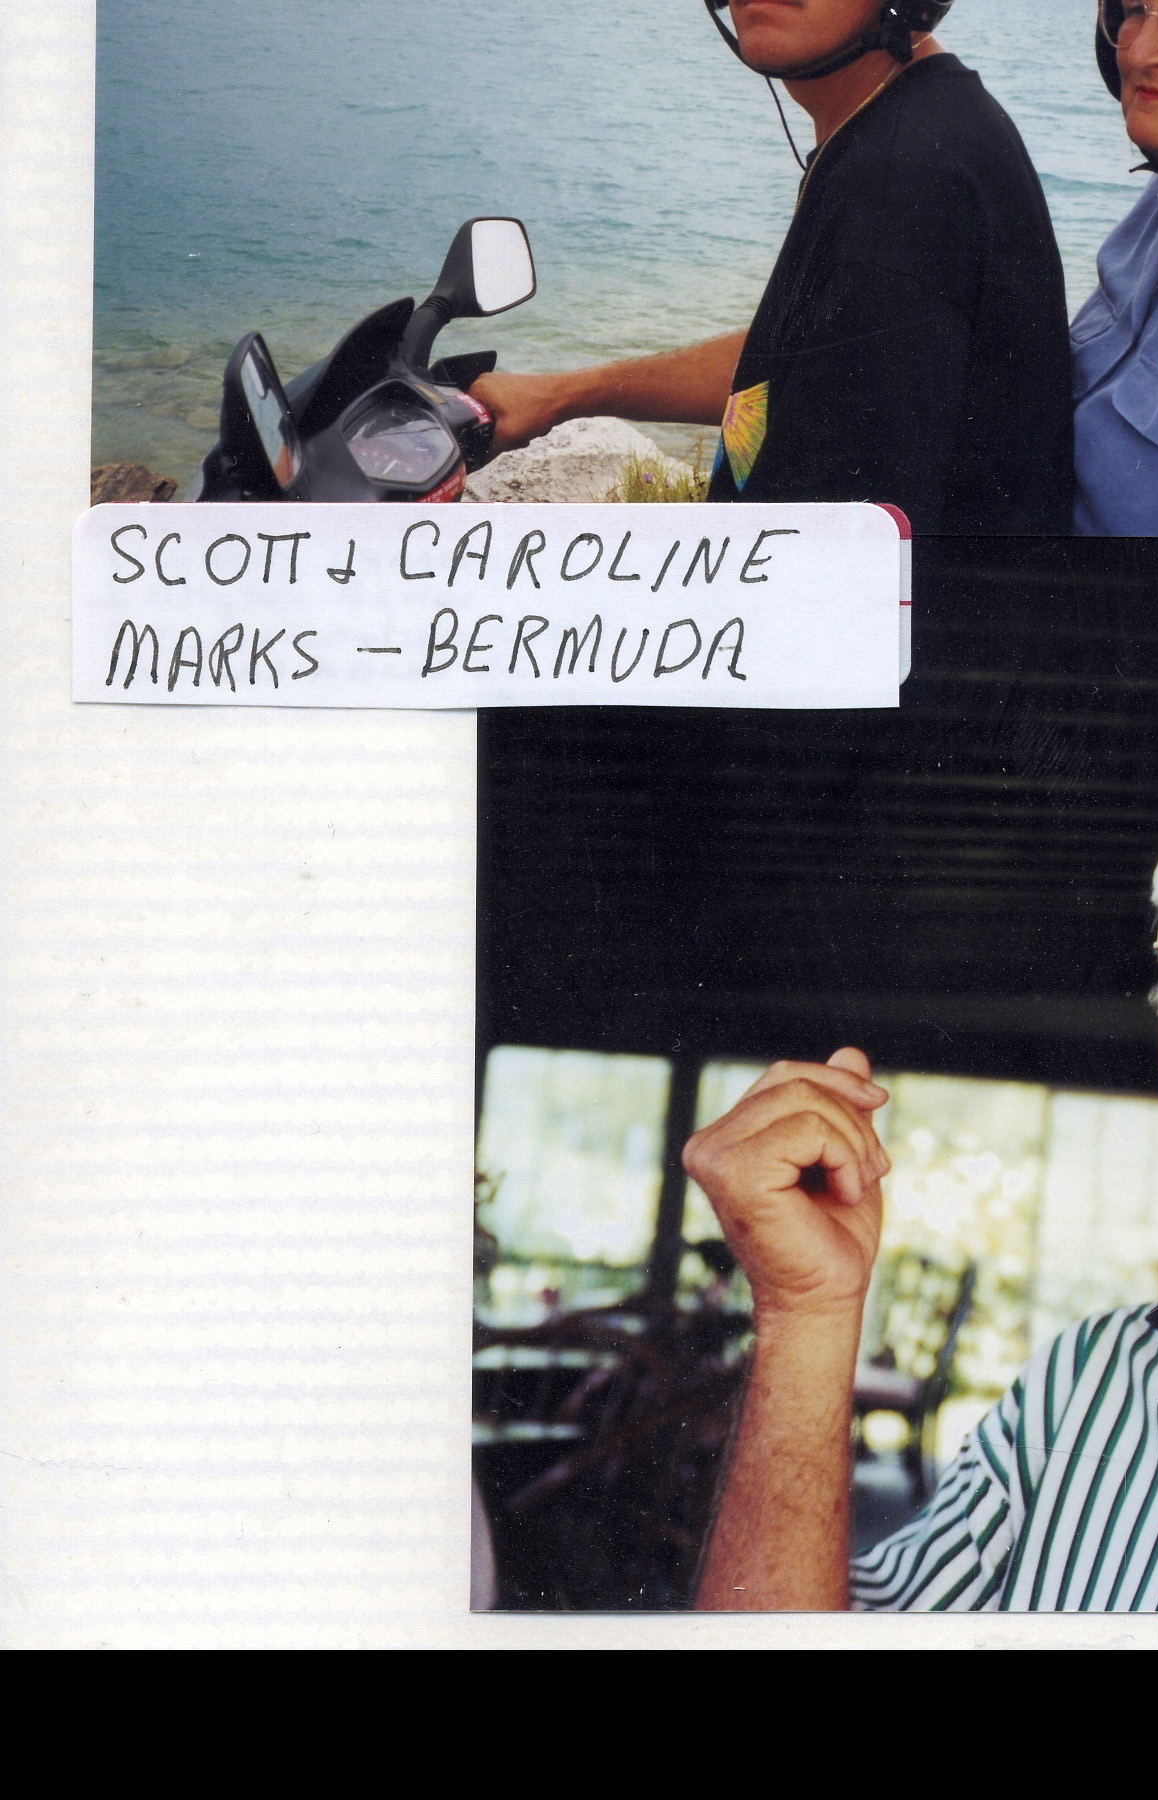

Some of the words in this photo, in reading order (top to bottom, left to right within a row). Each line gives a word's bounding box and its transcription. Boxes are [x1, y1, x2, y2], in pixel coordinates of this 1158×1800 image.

[110, 523, 312, 588] SCOTT
[399, 518, 801, 594] CAROLINE
[105, 618, 320, 693] MARKS
[421, 607, 748, 684] BERMUDA
